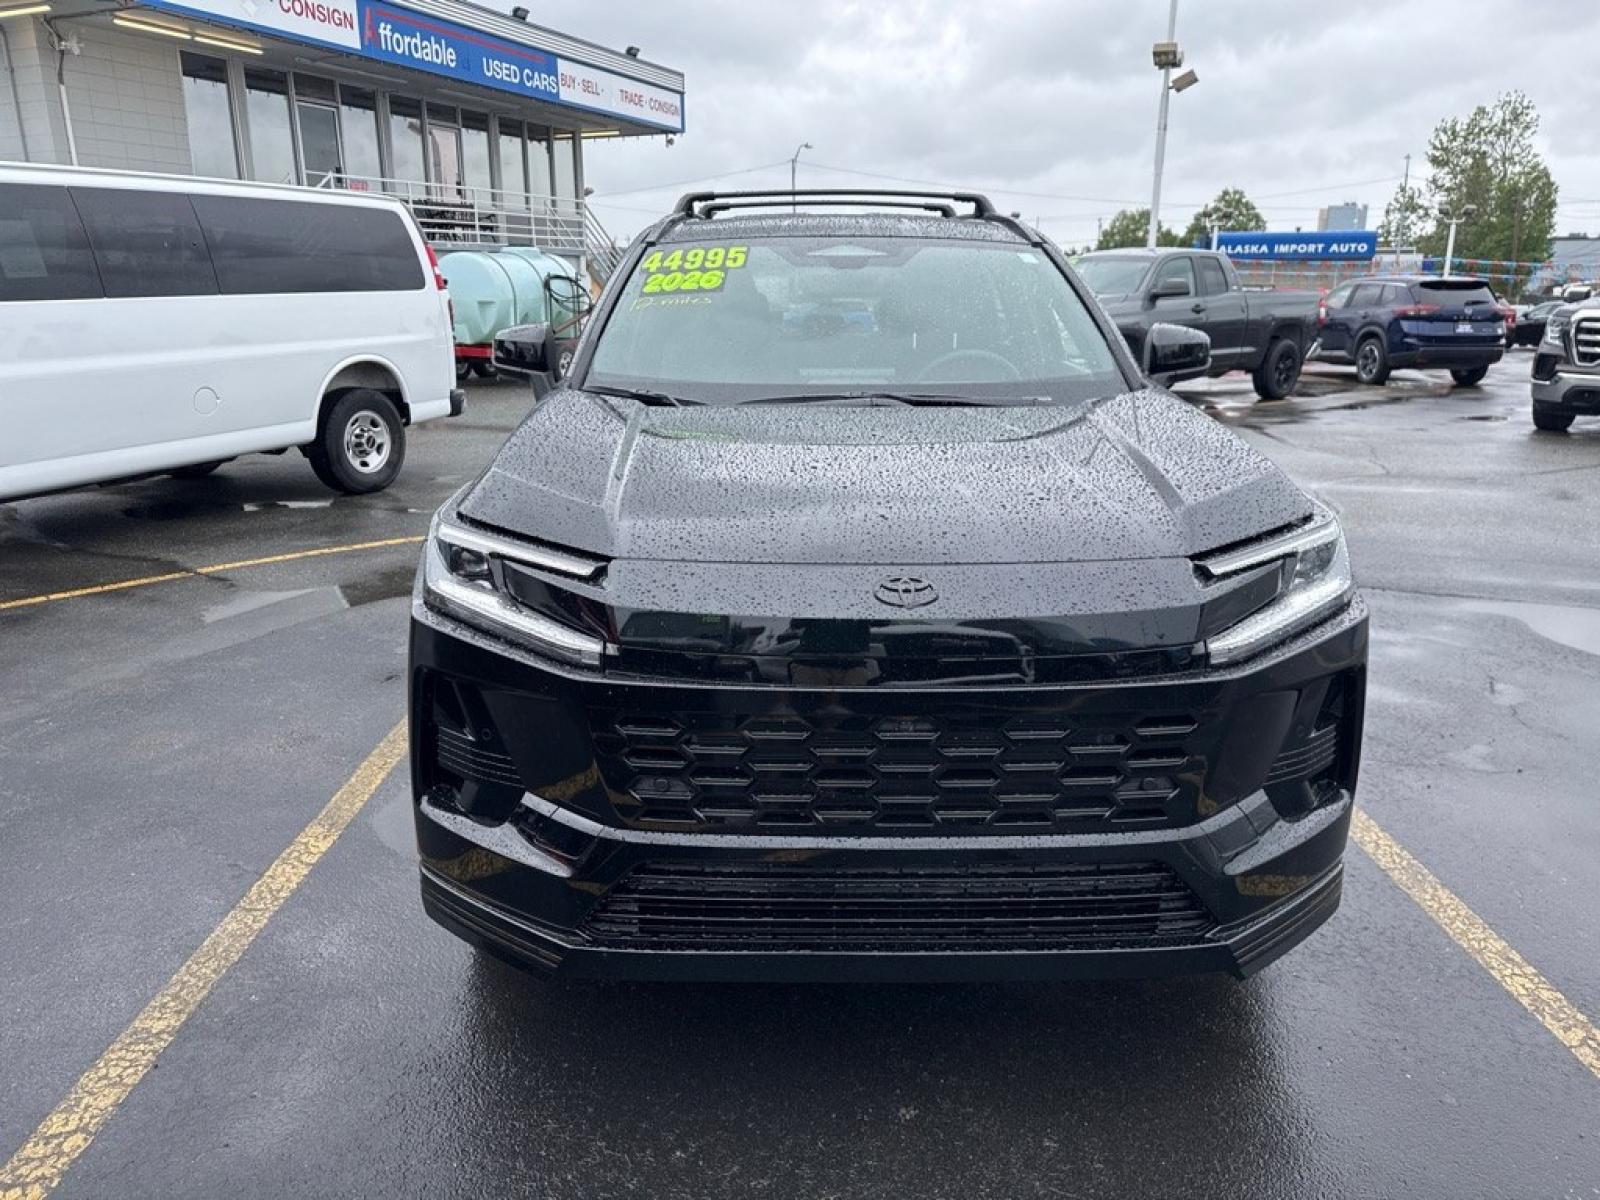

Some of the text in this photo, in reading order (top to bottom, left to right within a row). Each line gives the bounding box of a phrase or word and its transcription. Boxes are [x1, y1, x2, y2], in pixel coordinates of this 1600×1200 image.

[279, 0, 354, 30] CONSIGN
[364, 7, 457, 67] Affordable
[483, 57, 557, 93] USED CARS
[560, 72, 680, 116] BUY SELL TRADE CONSIGN
[642, 247, 747, 272] 44995
[1219, 242, 1368, 255] ALASKA IMPORT AUTO
[643, 270, 724, 293] 2026
